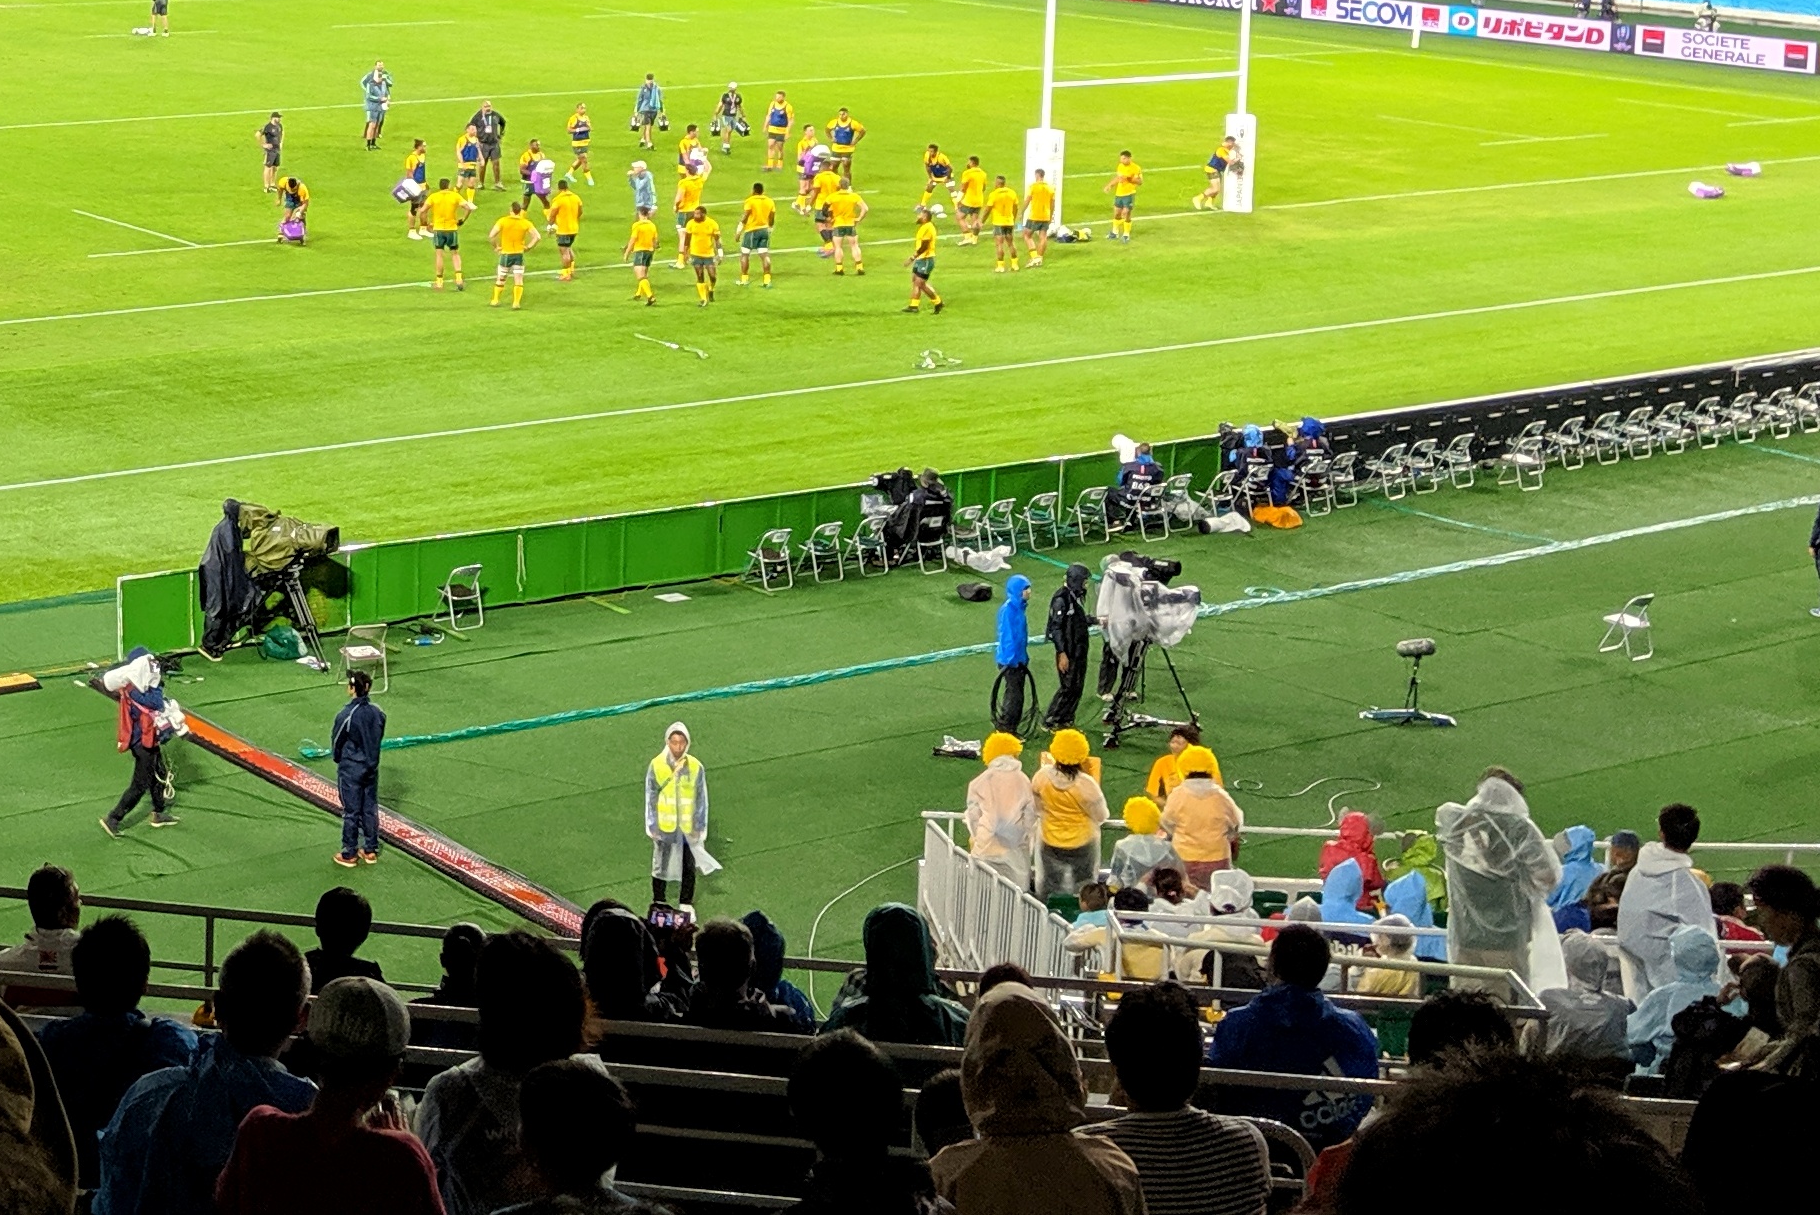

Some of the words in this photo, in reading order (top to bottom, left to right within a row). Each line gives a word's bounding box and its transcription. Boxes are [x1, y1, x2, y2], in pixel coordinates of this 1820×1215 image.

[1457, 16, 1470, 26] D
[1483, 16, 1605, 45] リポビタンD
[1682, 32, 1750, 50] SOCIETE
[1680, 45, 1766, 66] GENERALE
